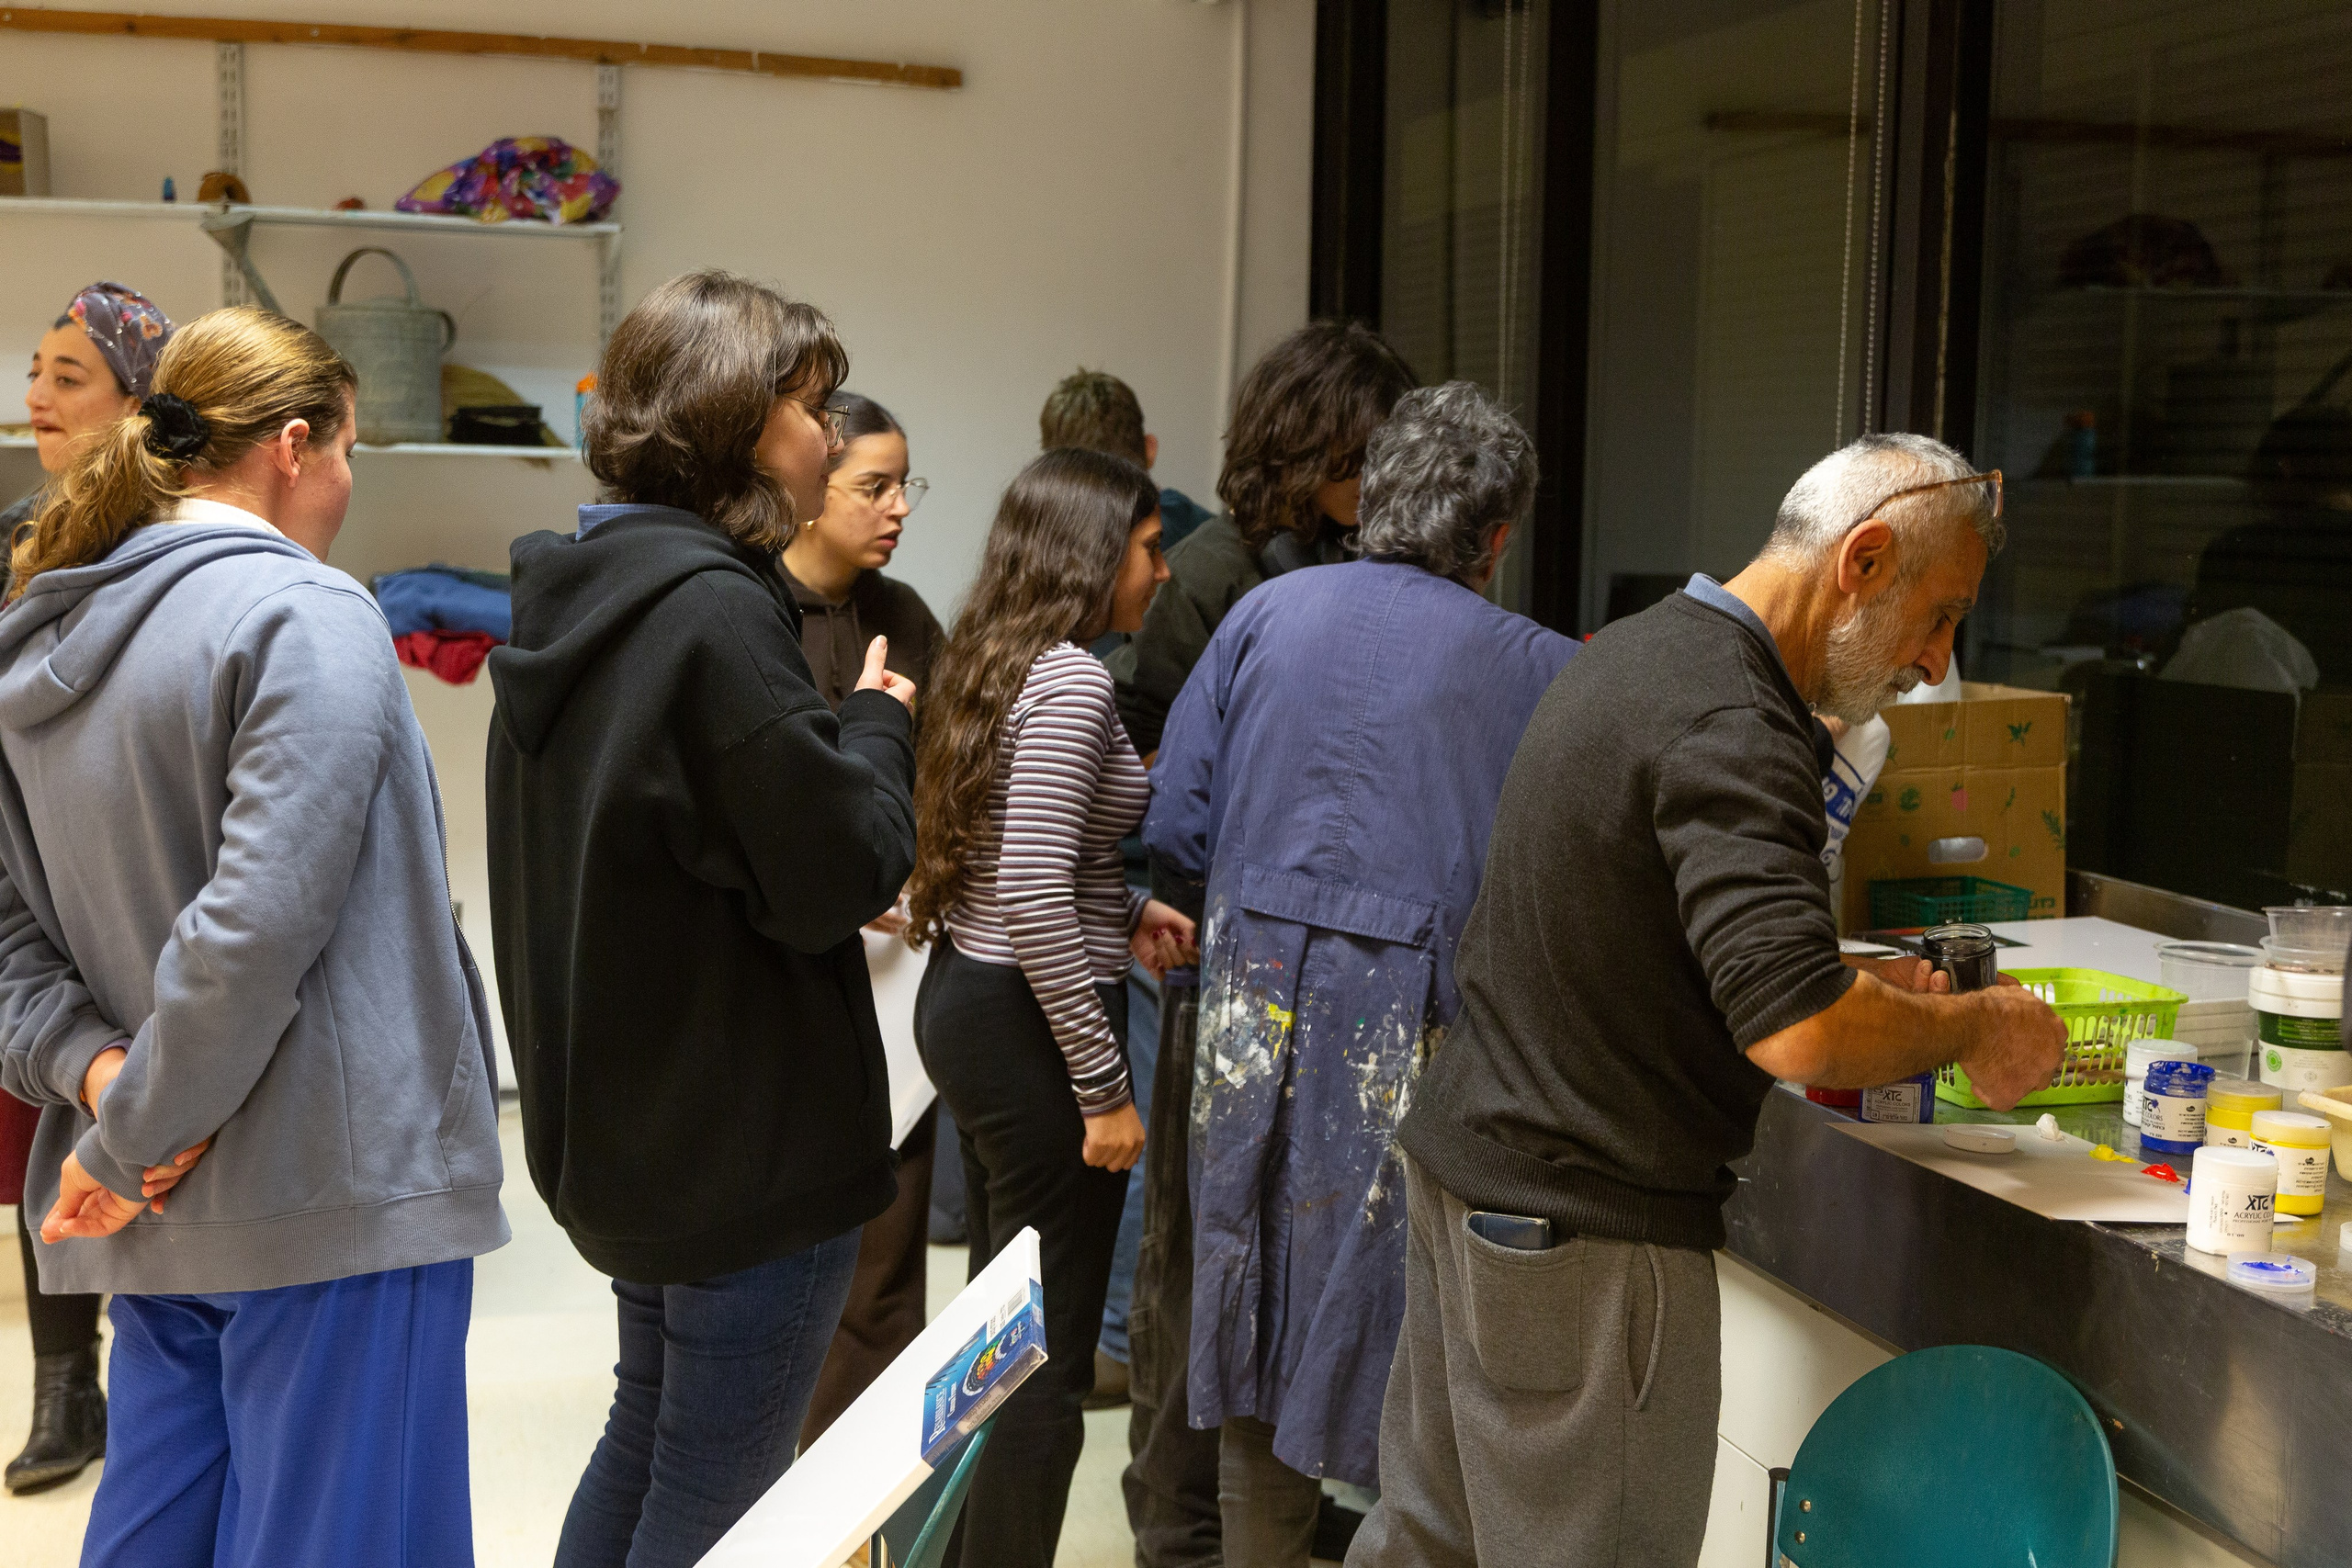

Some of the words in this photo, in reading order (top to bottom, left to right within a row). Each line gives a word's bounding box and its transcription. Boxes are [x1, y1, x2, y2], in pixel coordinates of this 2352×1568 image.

[1883, 1089, 1903, 1101] XTC
[2245, 1194, 2269, 1211] XTC
[2233, 1212, 2262, 1220] ACRYLIC
